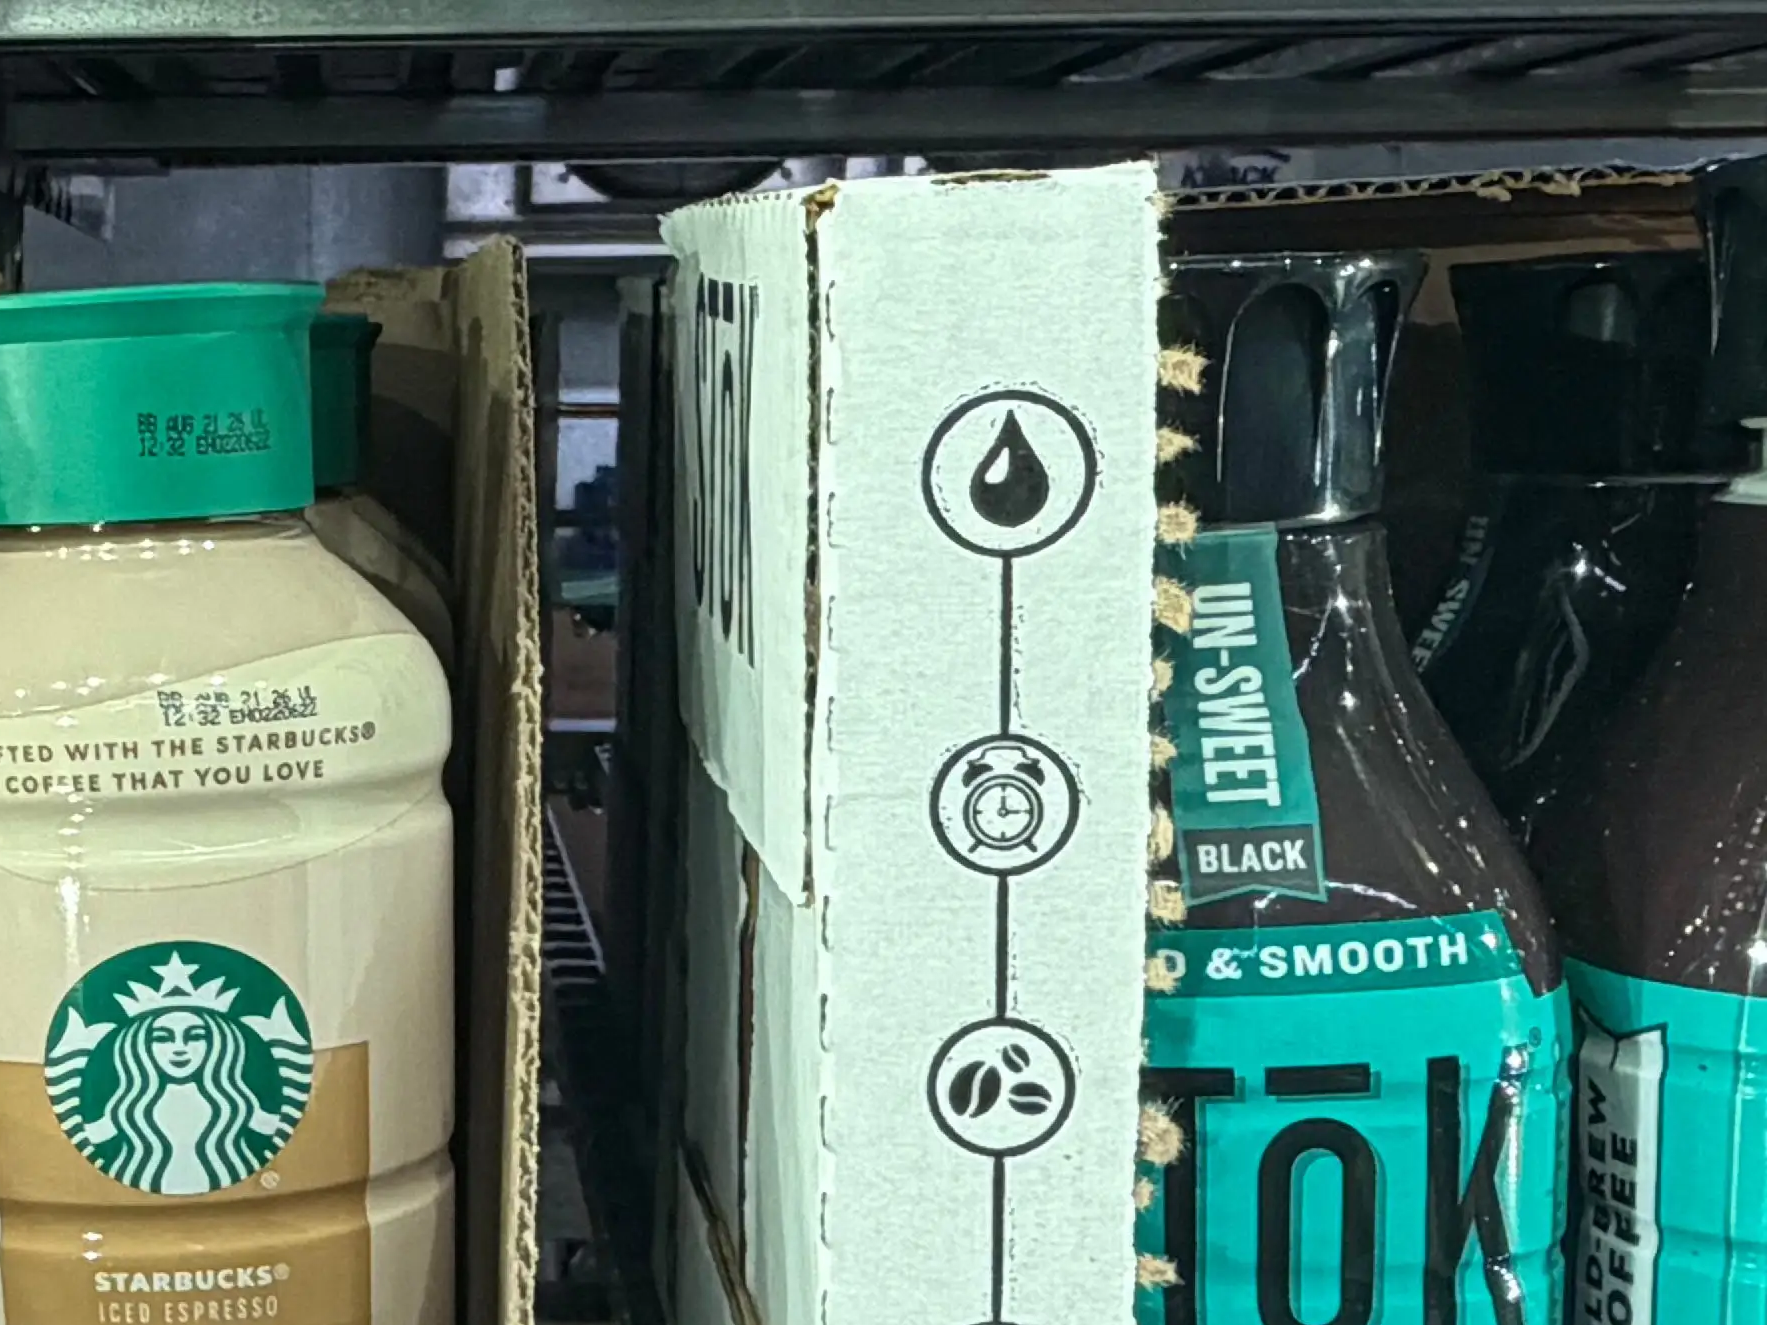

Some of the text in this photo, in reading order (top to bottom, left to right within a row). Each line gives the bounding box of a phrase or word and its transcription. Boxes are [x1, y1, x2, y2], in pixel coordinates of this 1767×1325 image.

[1192, 580, 1282, 808] UN-SWEET
[64, 740, 139, 761] WITH
[151, 737, 204, 758] THE
[5, 759, 325, 795] COFFEE THAT YOU LOVE
[1196, 838, 1308, 875] BLACK
[1205, 948, 1244, 981] &
[1259, 931, 1469, 978] SMOOTH
[97, 1295, 279, 1324] ICED ESPRESSO
